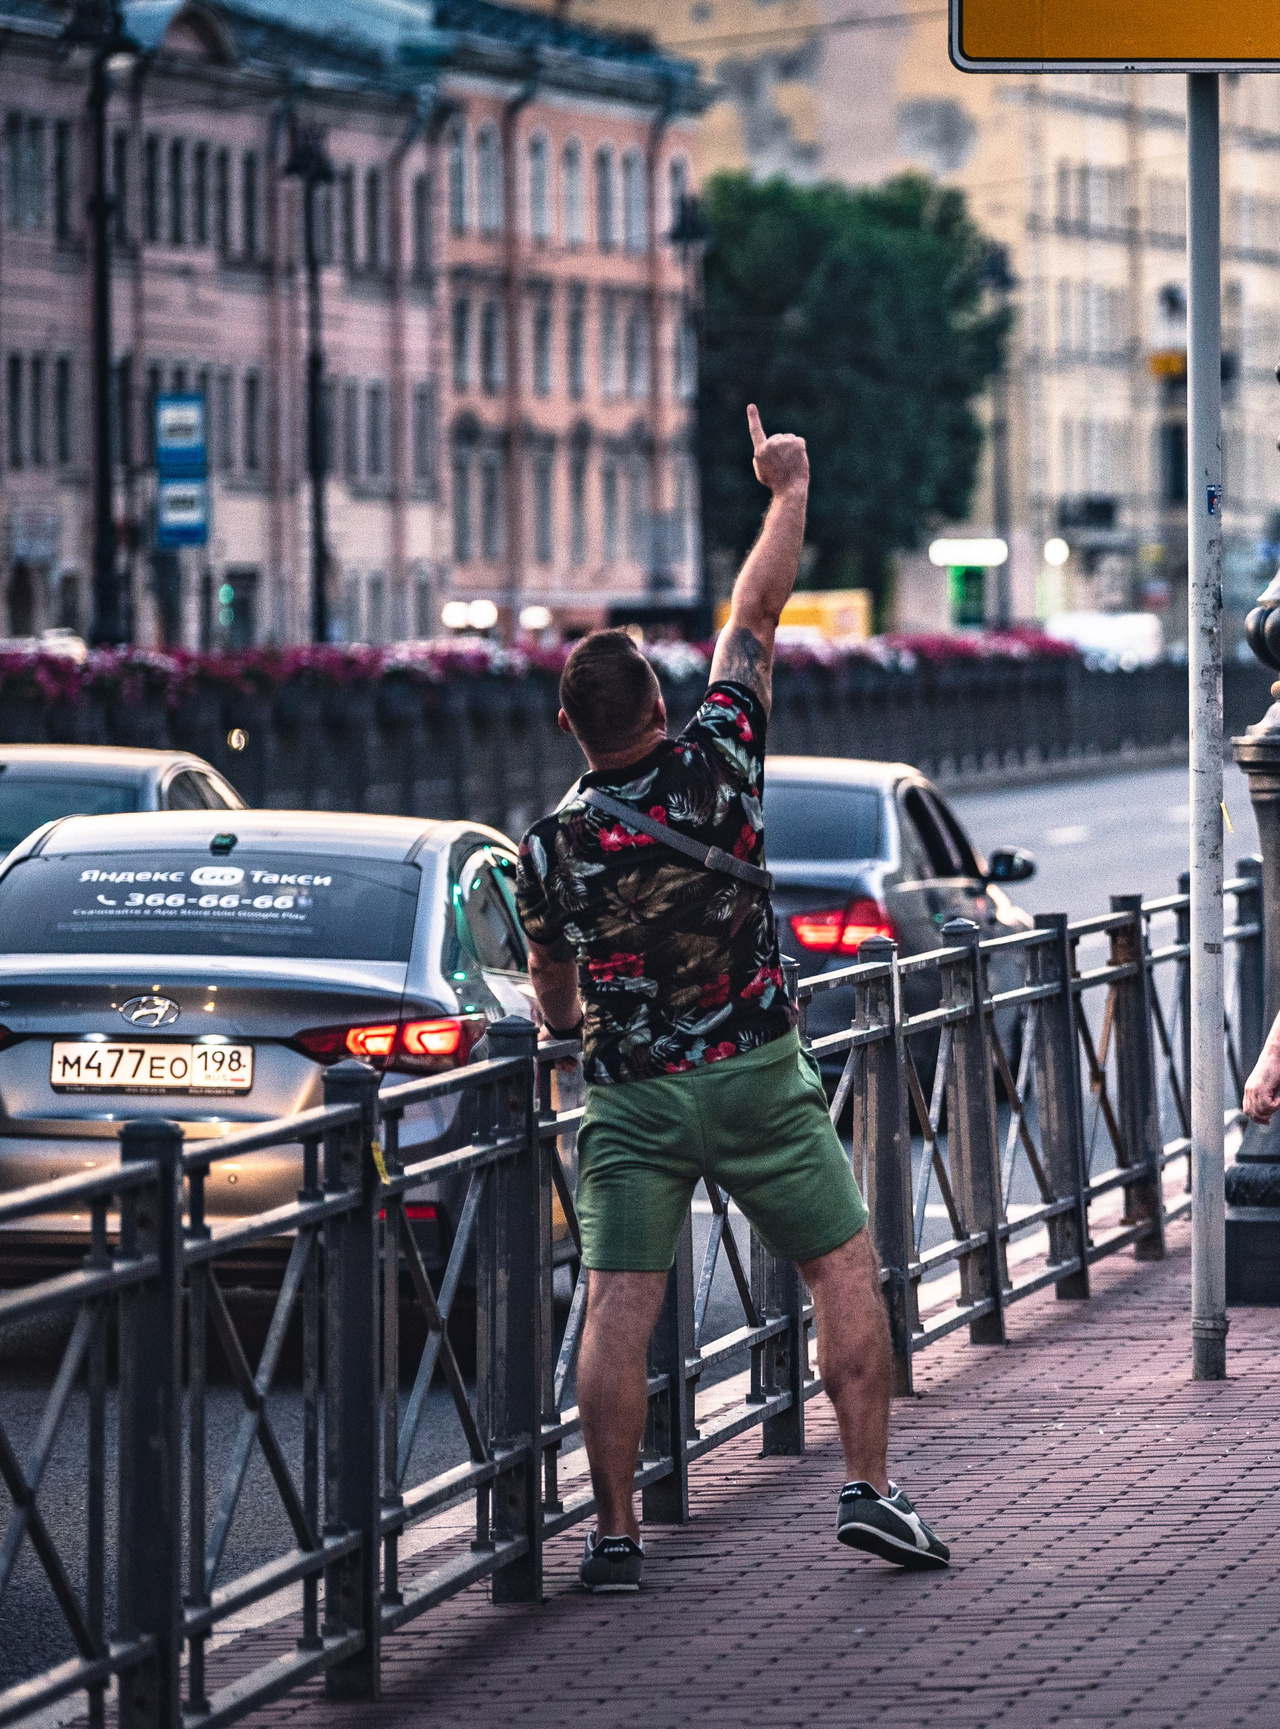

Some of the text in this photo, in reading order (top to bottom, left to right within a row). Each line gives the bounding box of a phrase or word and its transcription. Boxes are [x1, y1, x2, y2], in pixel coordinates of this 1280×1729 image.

[79, 869, 186, 883] Яндекс
[250, 870, 332, 886] Такси
[124, 892, 294, 909] 366-66-66
[197, 1050, 242, 1072] 198
